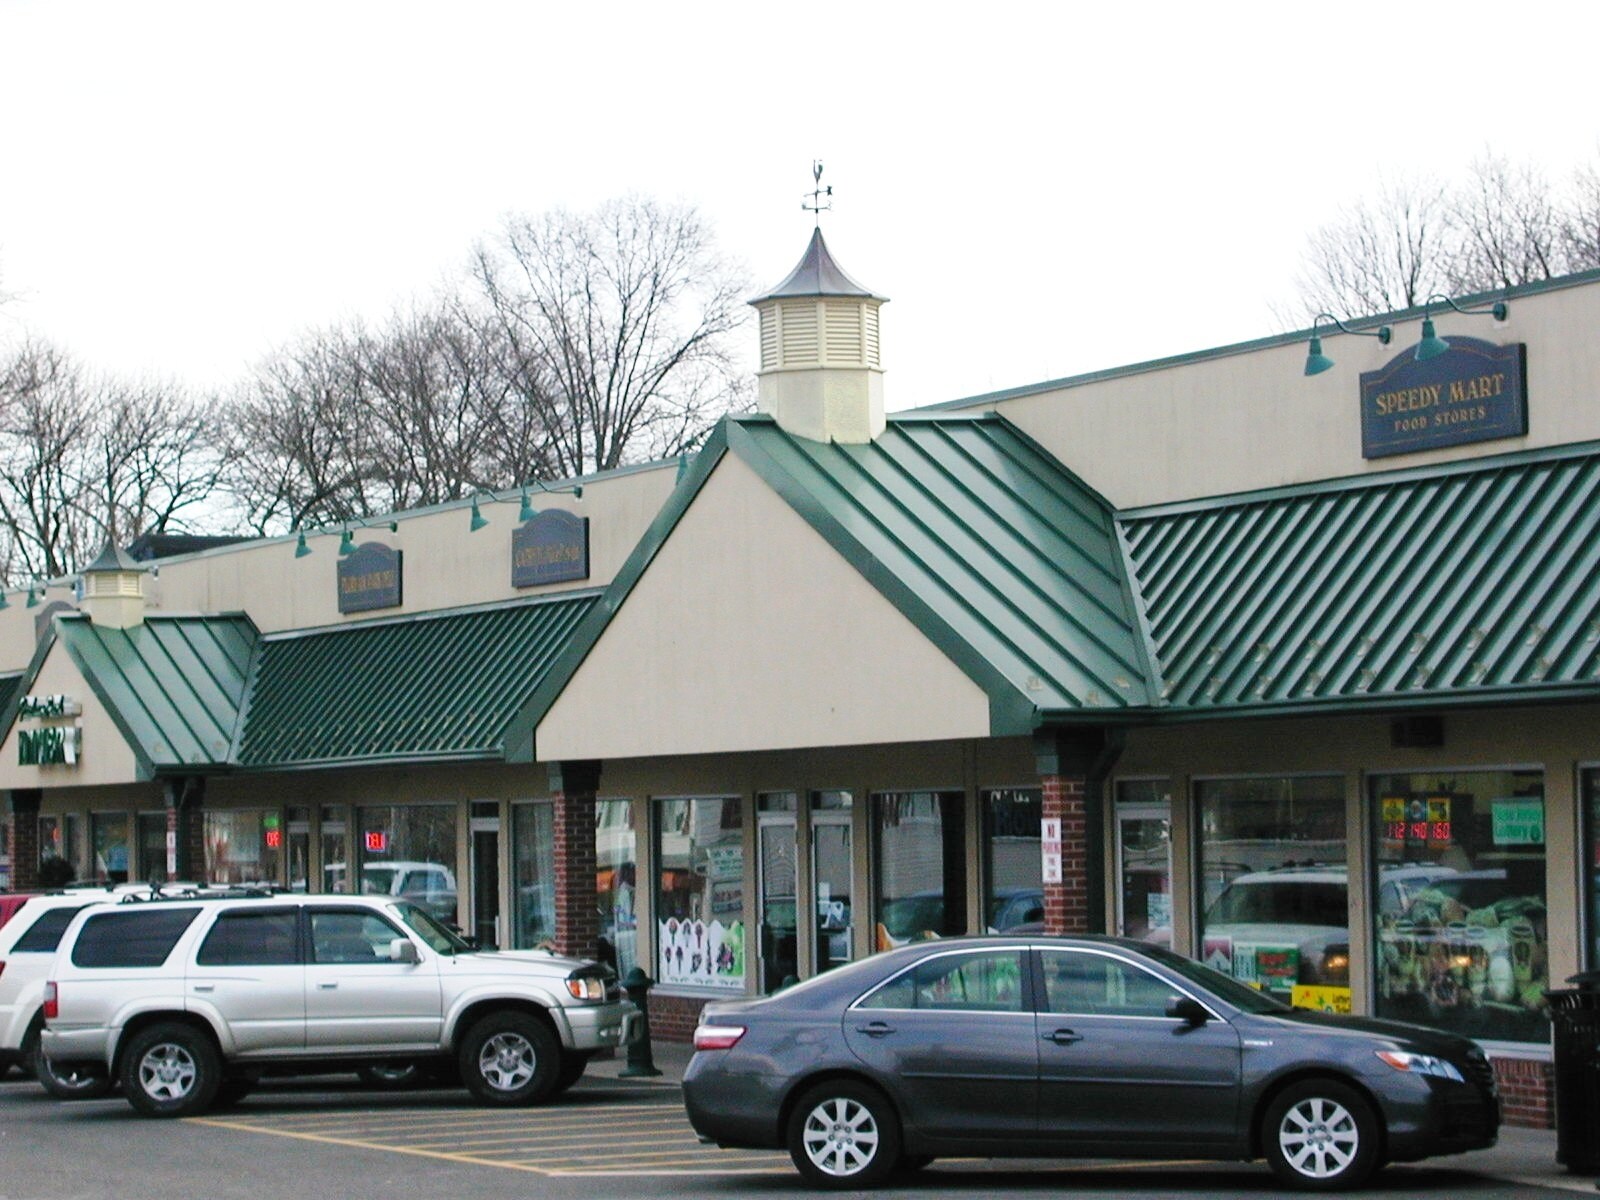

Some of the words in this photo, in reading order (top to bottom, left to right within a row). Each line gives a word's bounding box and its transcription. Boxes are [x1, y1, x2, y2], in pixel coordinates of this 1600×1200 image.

[1376, 385, 1442, 415] SPEEDY
[1449, 374, 1504, 403] MART
[1394, 416, 1428, 432] FOOD
[1435, 405, 1486, 425] STORES
